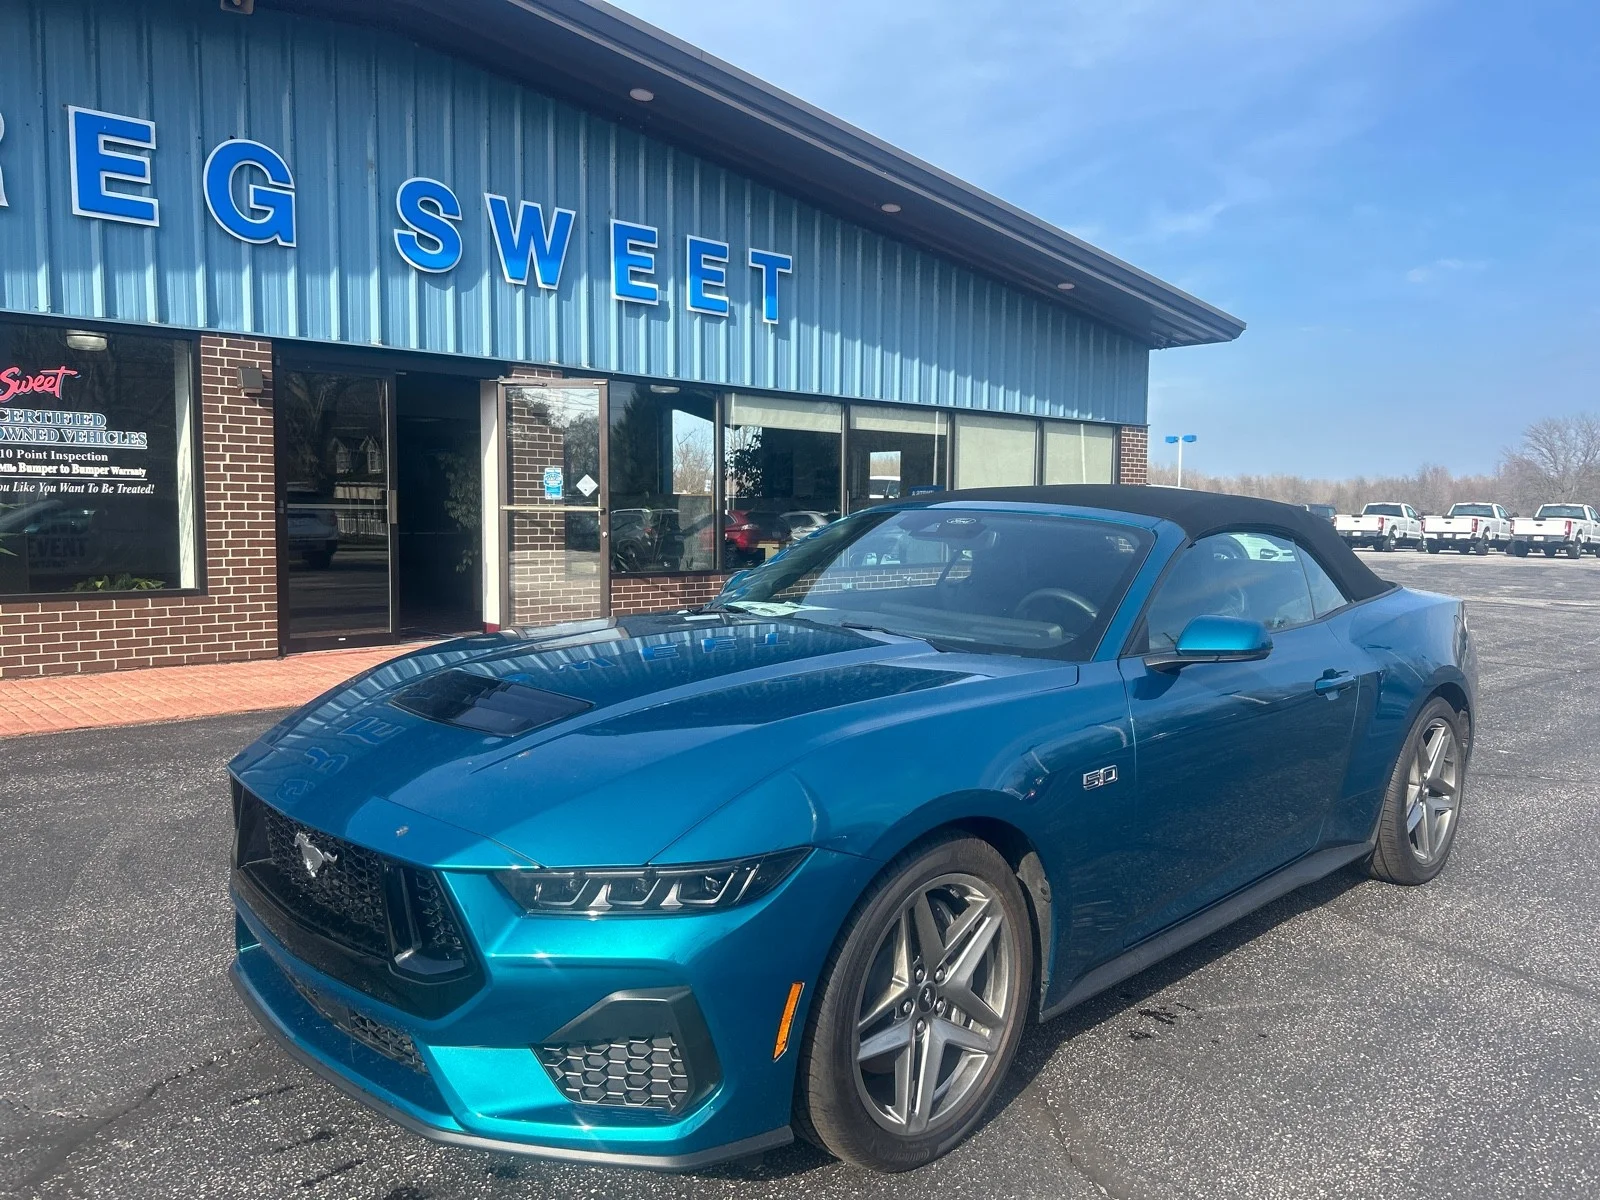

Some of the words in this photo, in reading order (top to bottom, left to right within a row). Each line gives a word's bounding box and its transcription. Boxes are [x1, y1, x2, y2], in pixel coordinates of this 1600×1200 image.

[0, 104, 297, 248] EG
[394, 177, 792, 325] SWEET
[0, 366, 80, 403] Sweet
[0, 407, 106, 427] CERTIFIED
[61, 428, 147, 446] VEHICLES
[17, 449, 47, 460] Point
[51, 450, 108, 462] Inspection
[18, 462, 58, 476] Bumper
[60, 464, 70, 474] to
[71, 463, 109, 477] Bumper
[110, 466, 146, 478] Warranty
[13, 481, 35, 493] Like
[39, 482, 56, 496] You
[60, 482, 84, 493] Want
[88, 483, 99, 493] To
[101, 483, 114, 494] Be
[117, 483, 155, 494] Treated!
